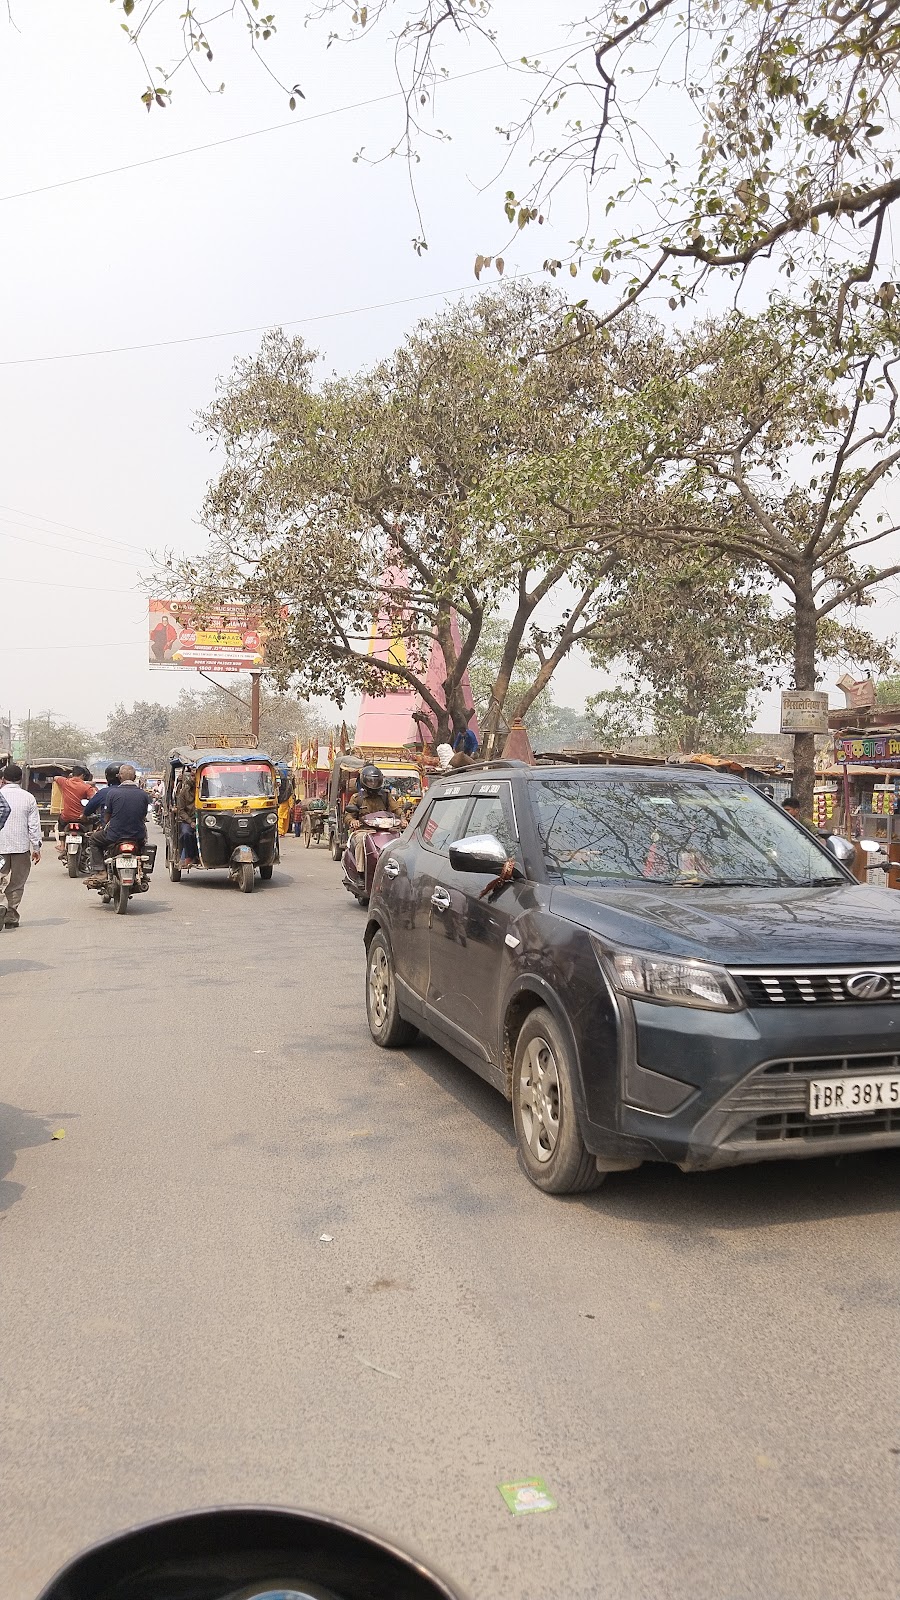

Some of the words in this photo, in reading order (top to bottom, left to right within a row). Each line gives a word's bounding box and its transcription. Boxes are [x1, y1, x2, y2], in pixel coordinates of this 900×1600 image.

[843, 738, 886, 758] पकवान
[824, 1086, 844, 1107] BR
[852, 1083, 883, 1105] 38X
[890, 1081, 899, 1102] 5
